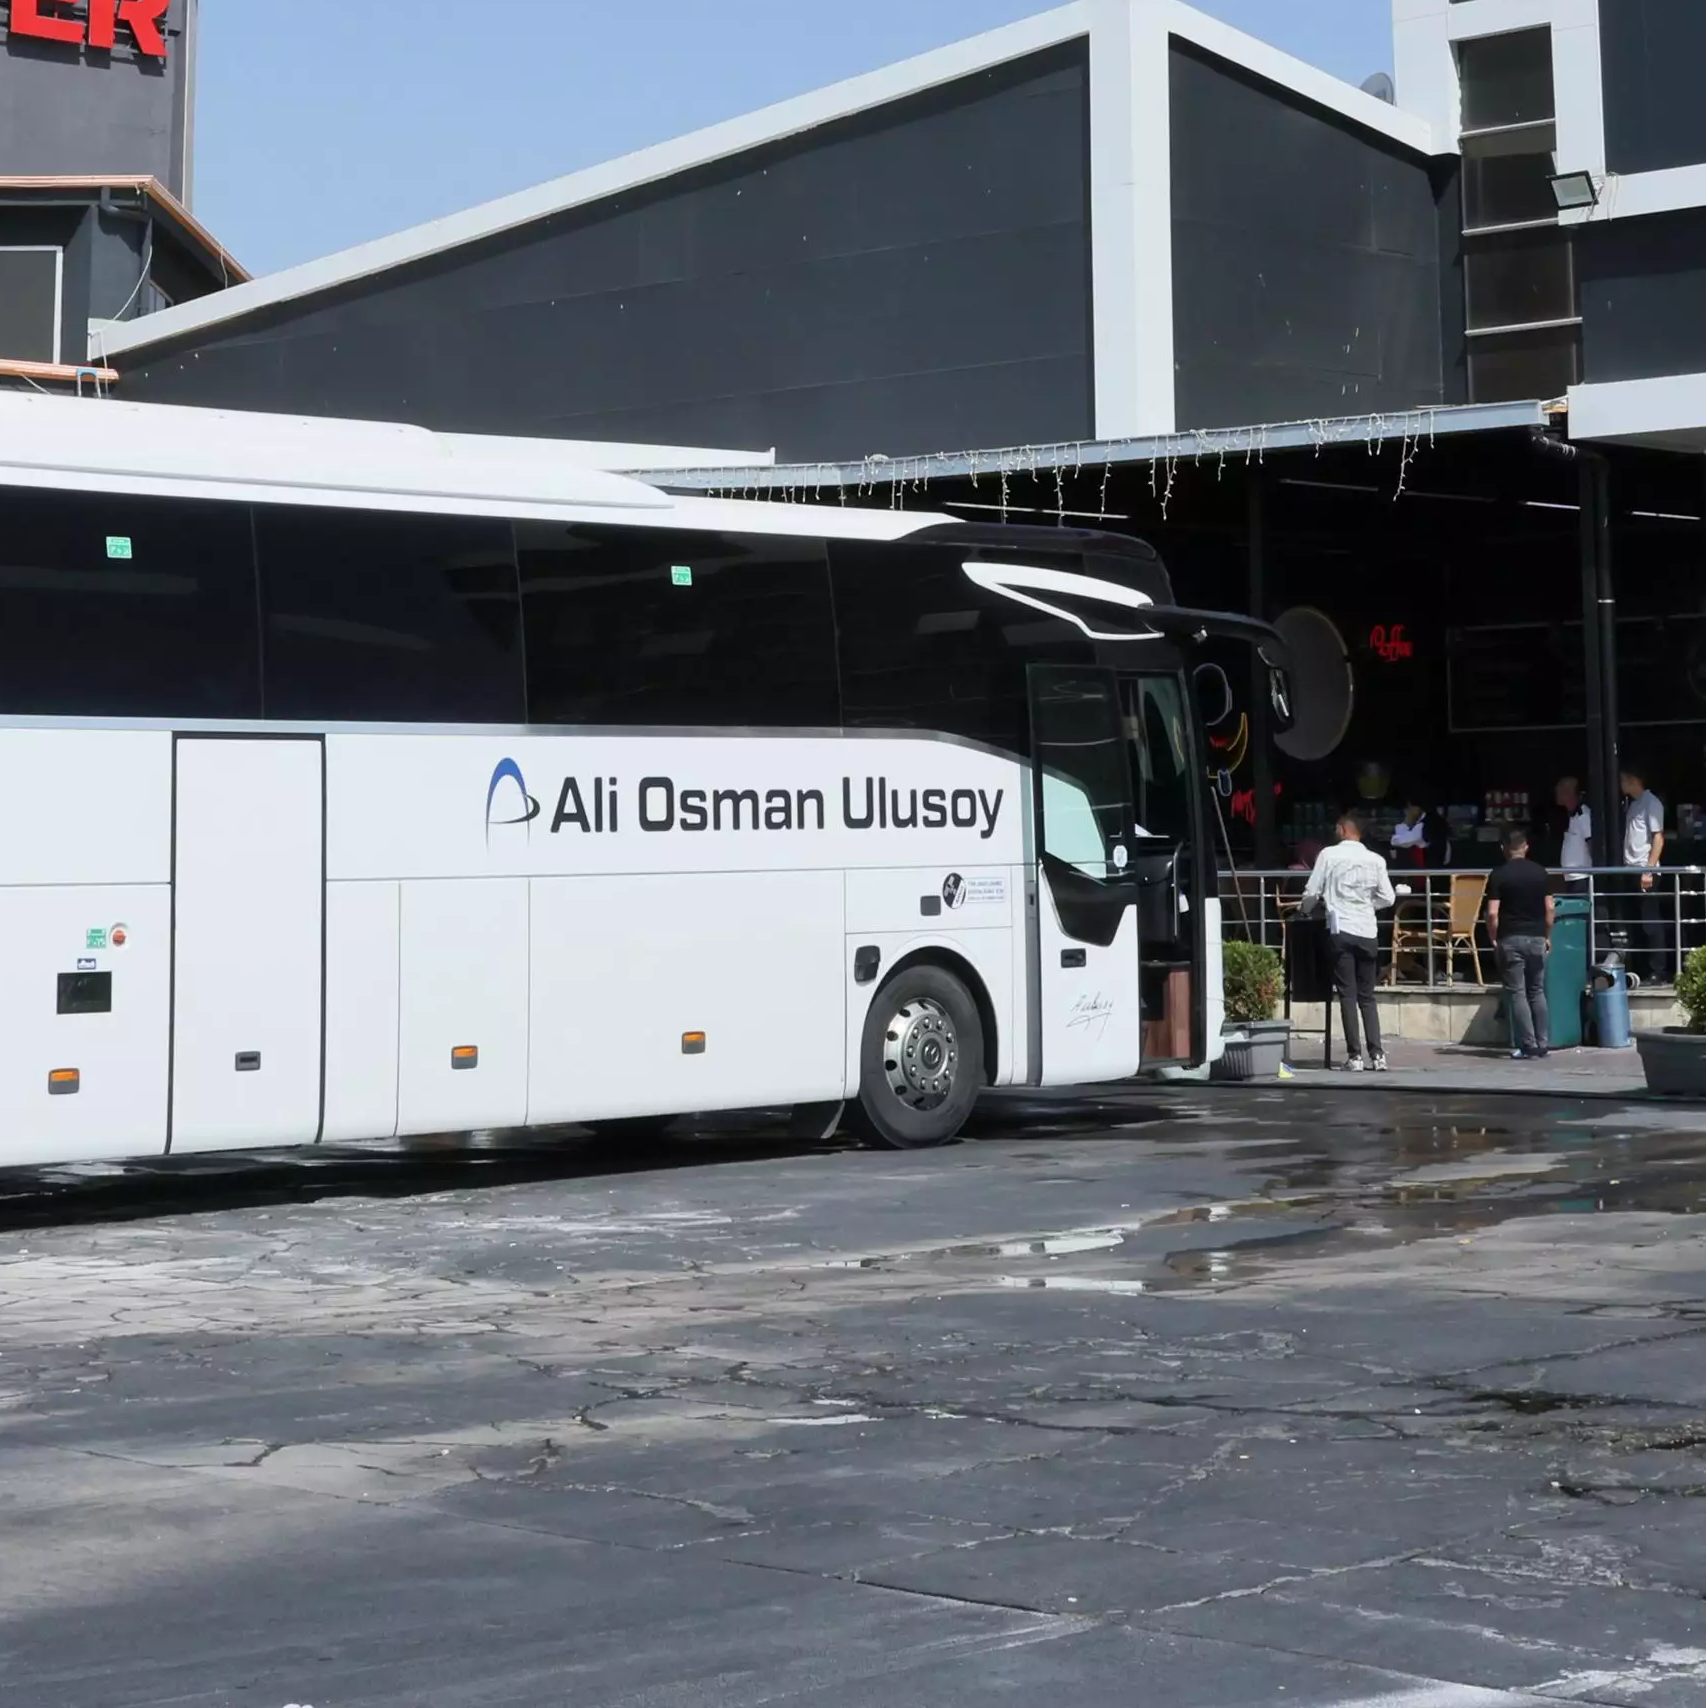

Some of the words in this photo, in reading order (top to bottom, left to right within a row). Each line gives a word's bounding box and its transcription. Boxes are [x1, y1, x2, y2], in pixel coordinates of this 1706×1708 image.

[550, 775, 618, 833] Ali
[638, 775, 825, 832] Osman
[842, 775, 1004, 839] Ulusoy
